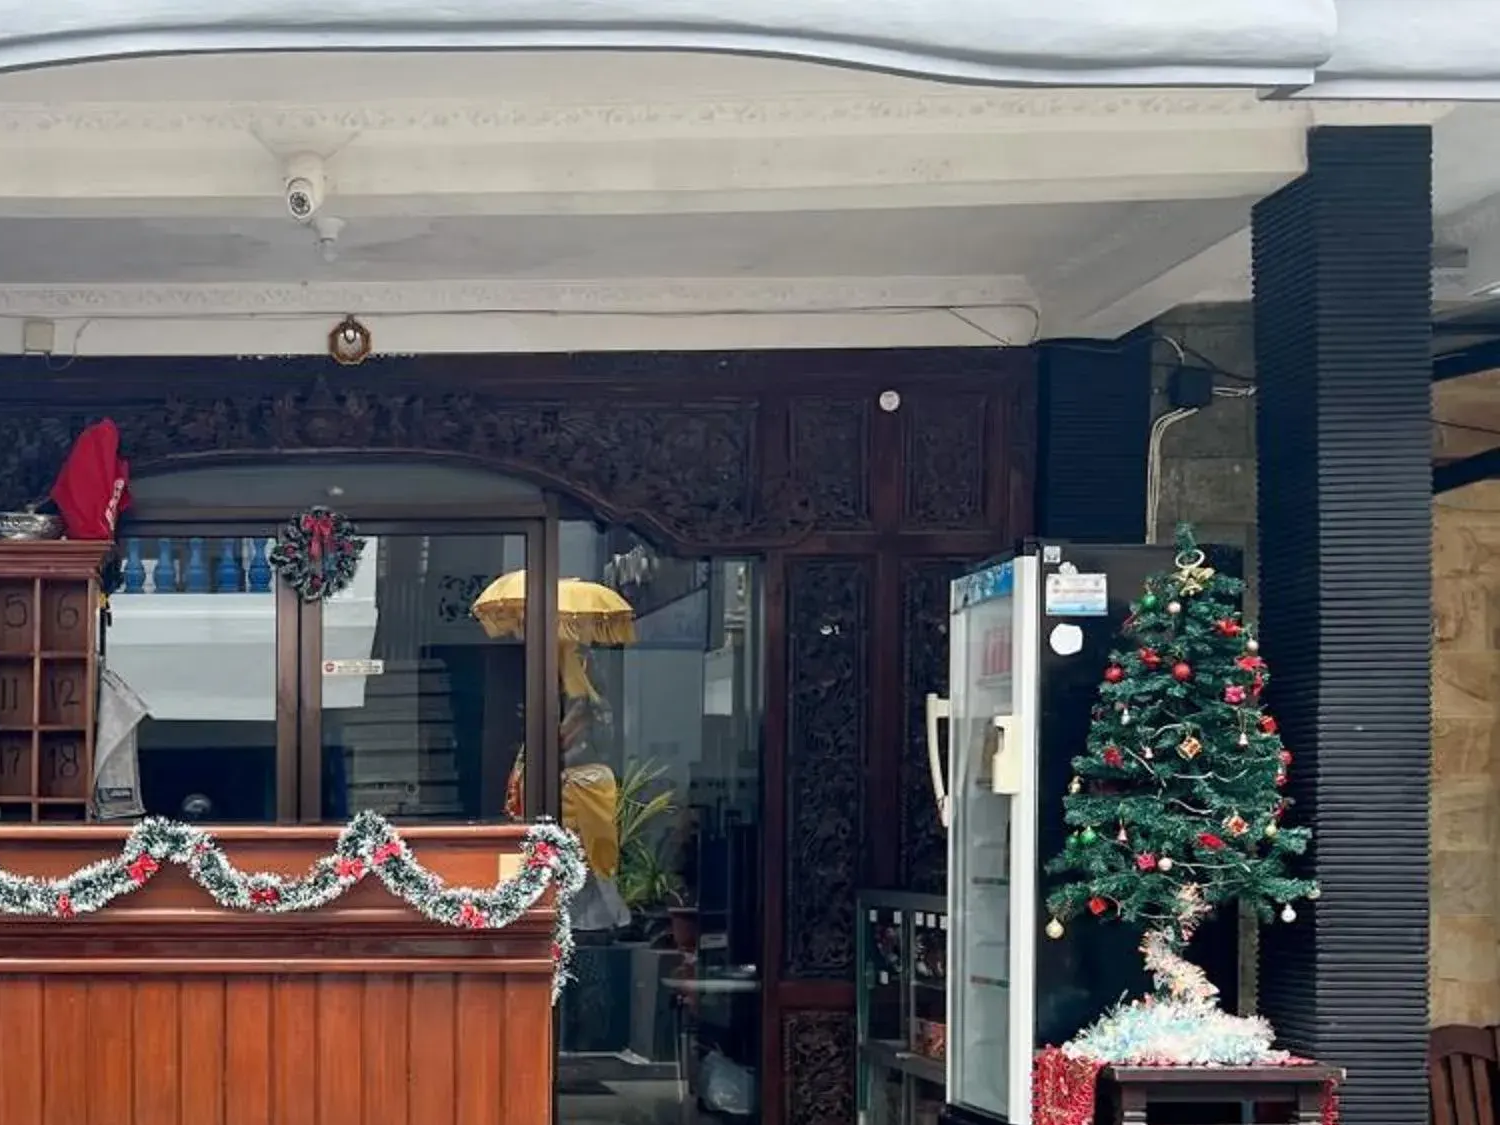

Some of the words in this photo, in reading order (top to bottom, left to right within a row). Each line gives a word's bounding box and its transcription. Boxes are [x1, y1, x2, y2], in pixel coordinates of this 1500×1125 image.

[5, 592, 28, 629] 5
[56, 592, 80, 630] 6
[0, 677, 20, 710] 11
[50, 678, 80, 707] 12
[51, 746, 80, 780] 18
